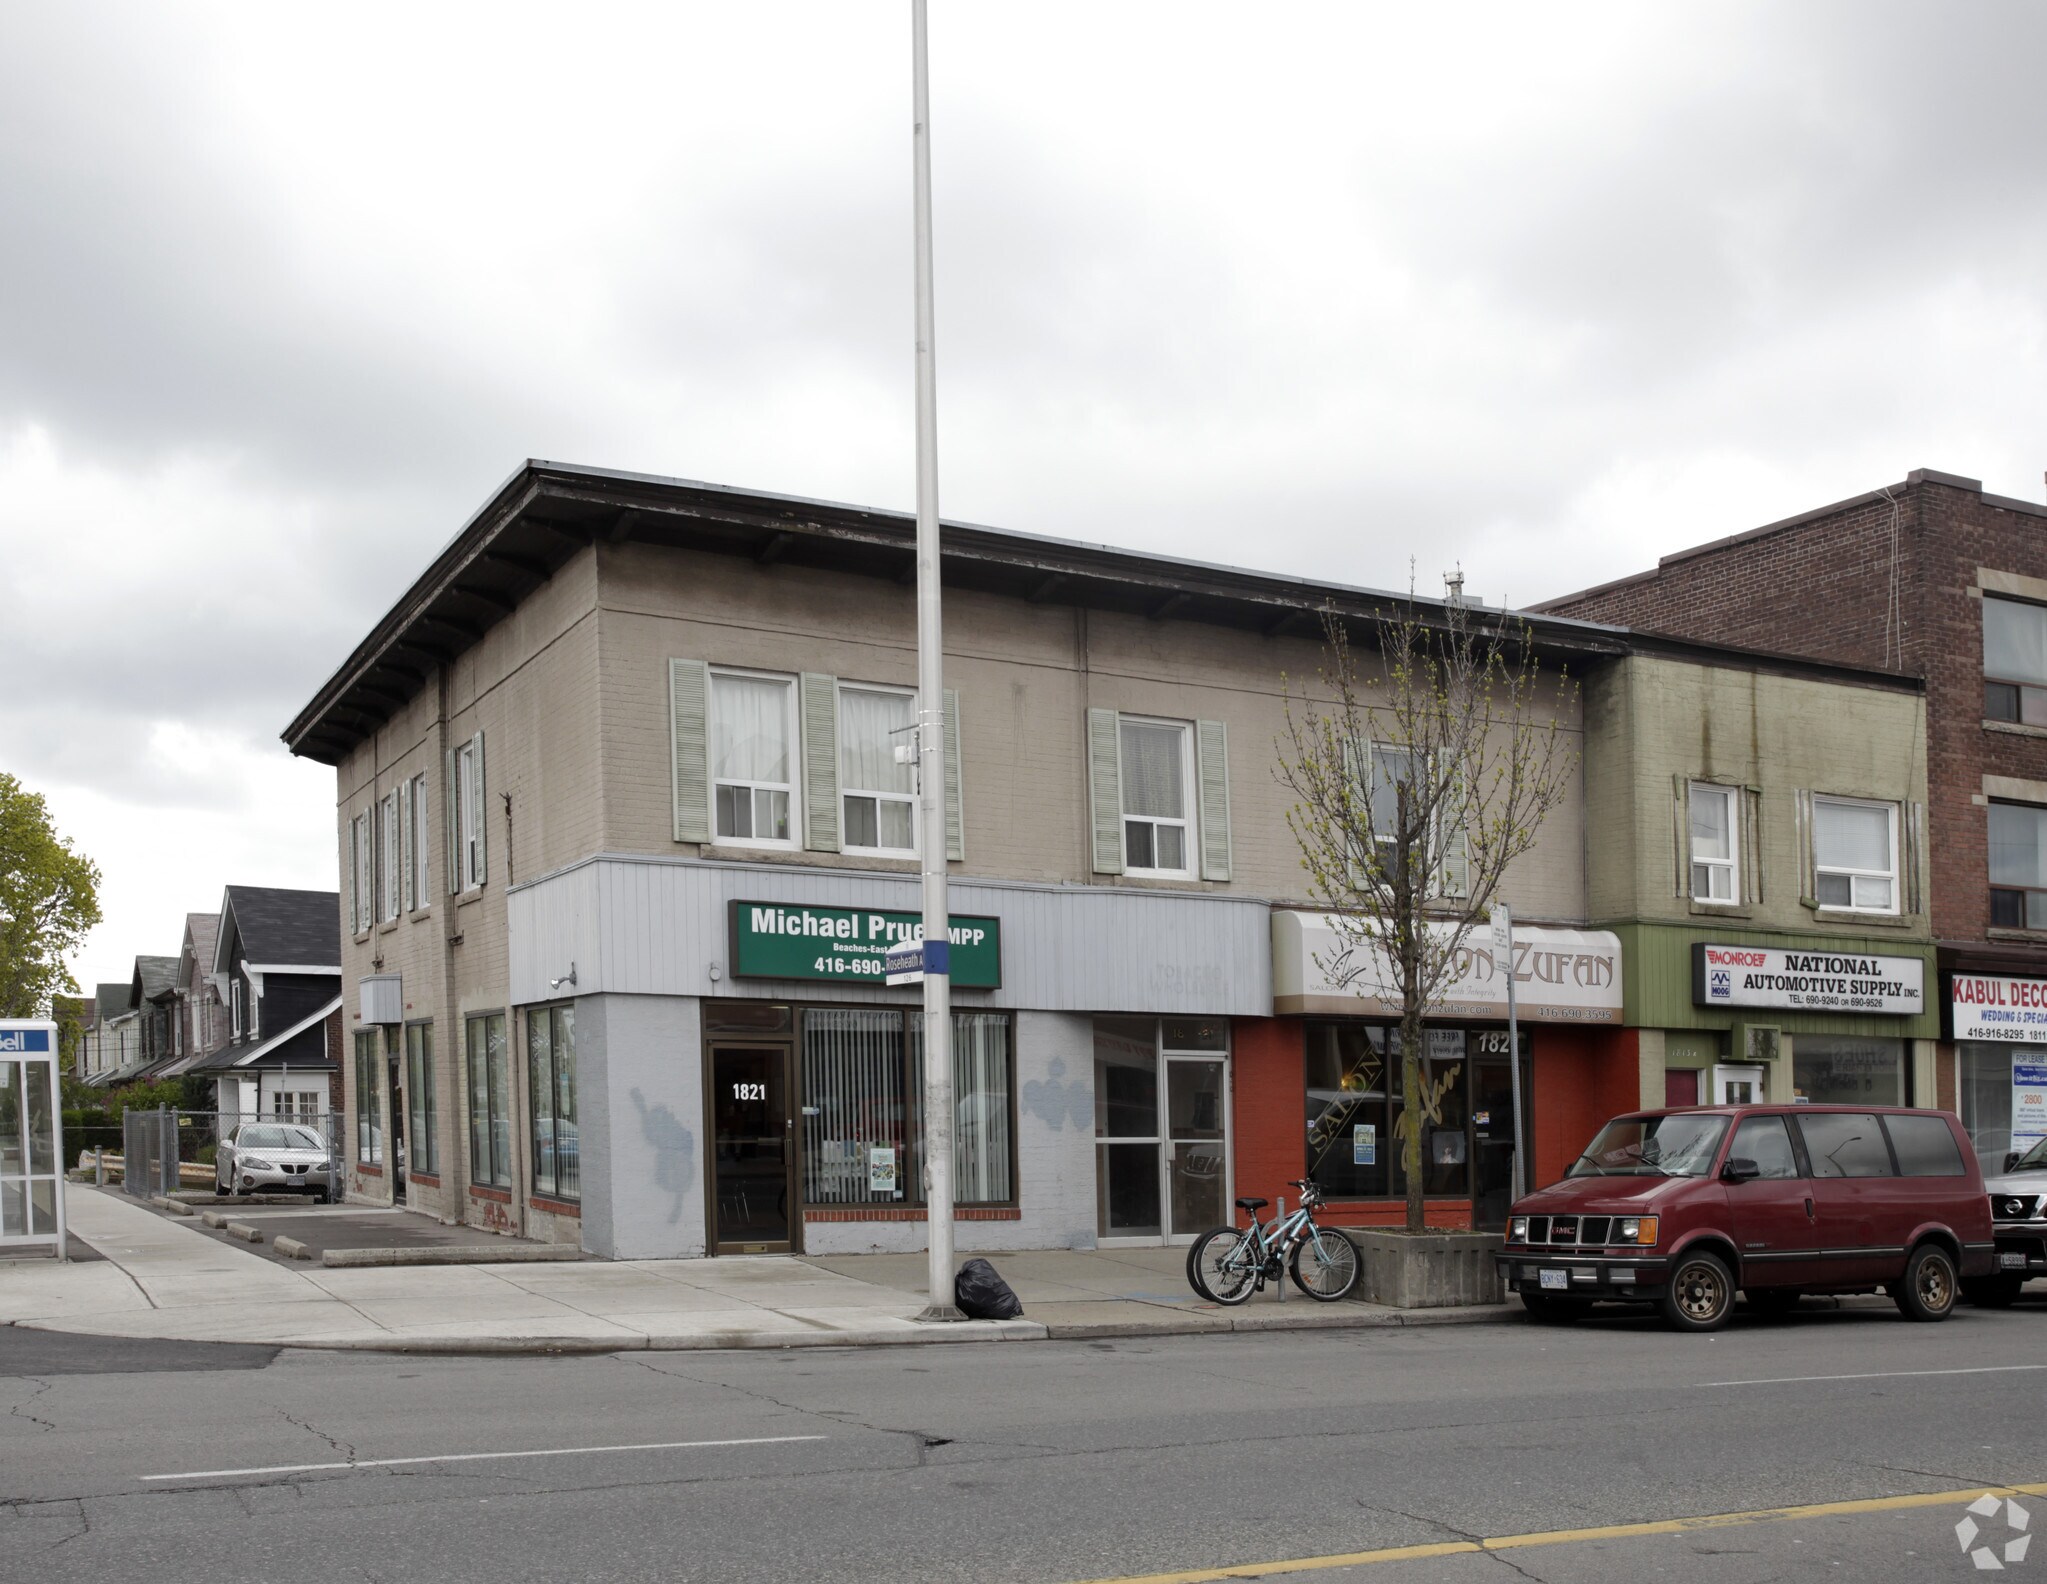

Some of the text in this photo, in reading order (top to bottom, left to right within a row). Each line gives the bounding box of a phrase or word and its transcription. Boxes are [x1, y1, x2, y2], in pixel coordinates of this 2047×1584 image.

[751, 907, 985, 946] Michael Prue MPP
[833, 942, 888, 954] Beaches-East
[814, 957, 885, 975] 416-690-
[886, 952, 919, 972] Roseheath
[1511, 941, 1614, 989] ZUFAN
[1714, 950, 1761, 967] MONROE
[1785, 955, 1882, 976] NATIONAL
[1711, 986, 1729, 996] MOOG
[1743, 973, 1920, 998] AUTOMOTIVE SUPPLY INC.
[1952, 978, 2006, 1006] KABUL
[1789, 994, 1805, 1004] TEL:
[1806, 995, 1839, 1006] 690-9240
[1850, 998, 1883, 1008] 690-9526
[1537, 1007, 1613, 1020] 416.690.3595
[1981, 1009, 2015, 1022] WEDDING
[2016, 1011, 2022, 1023] &
[0, 1031, 25, 1050] ell
[1967, 1027, 2024, 1040] 416-916-8295
[2015, 1054, 2045, 1064] FOR LEASE
[732, 1083, 766, 1100] 1821
[1308, 1050, 1383, 1154] SALON
[1551, 1226, 1576, 1235] GMC
